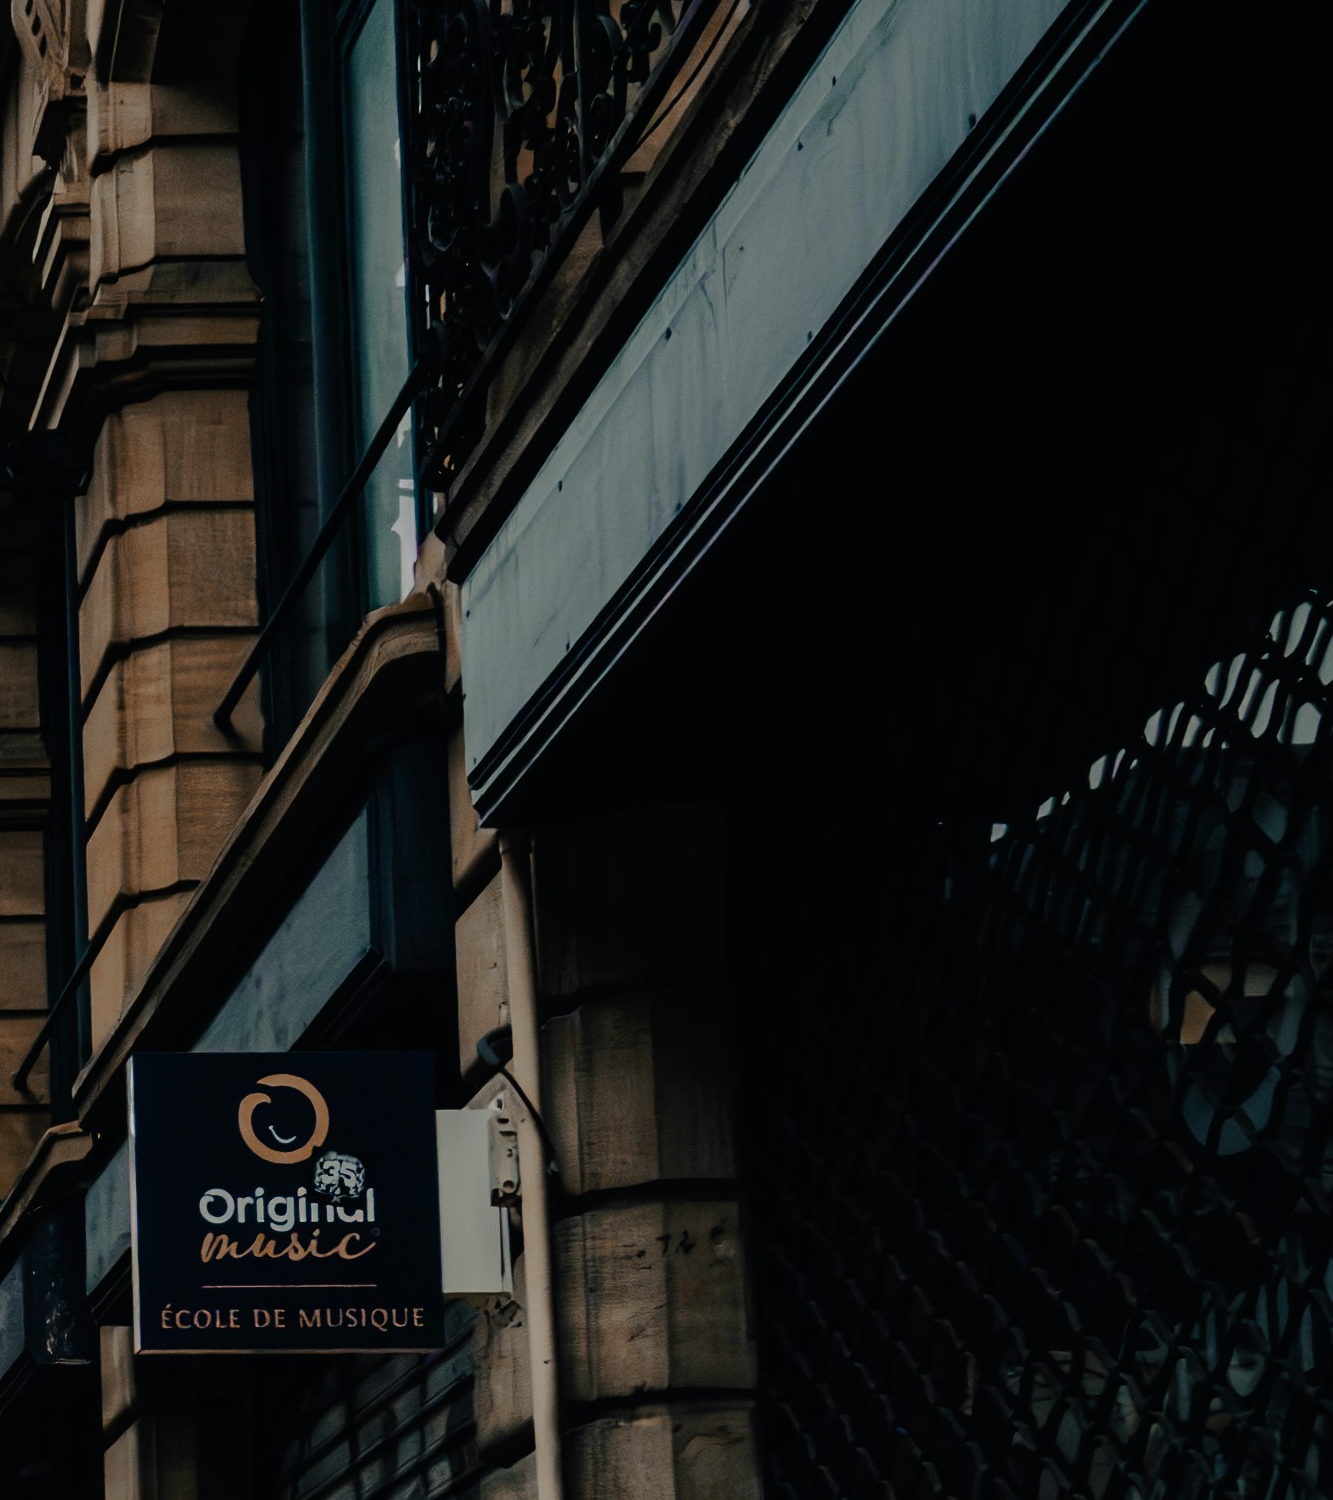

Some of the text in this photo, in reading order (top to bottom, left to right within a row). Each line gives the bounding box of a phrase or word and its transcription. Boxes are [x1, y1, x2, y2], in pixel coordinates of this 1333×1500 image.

[321, 1160, 357, 1188] 35
[199, 1187, 375, 1232] Original
[201, 1228, 376, 1263] music
[161, 1303, 424, 1332] ÉCOLE DE MUSIQUE
